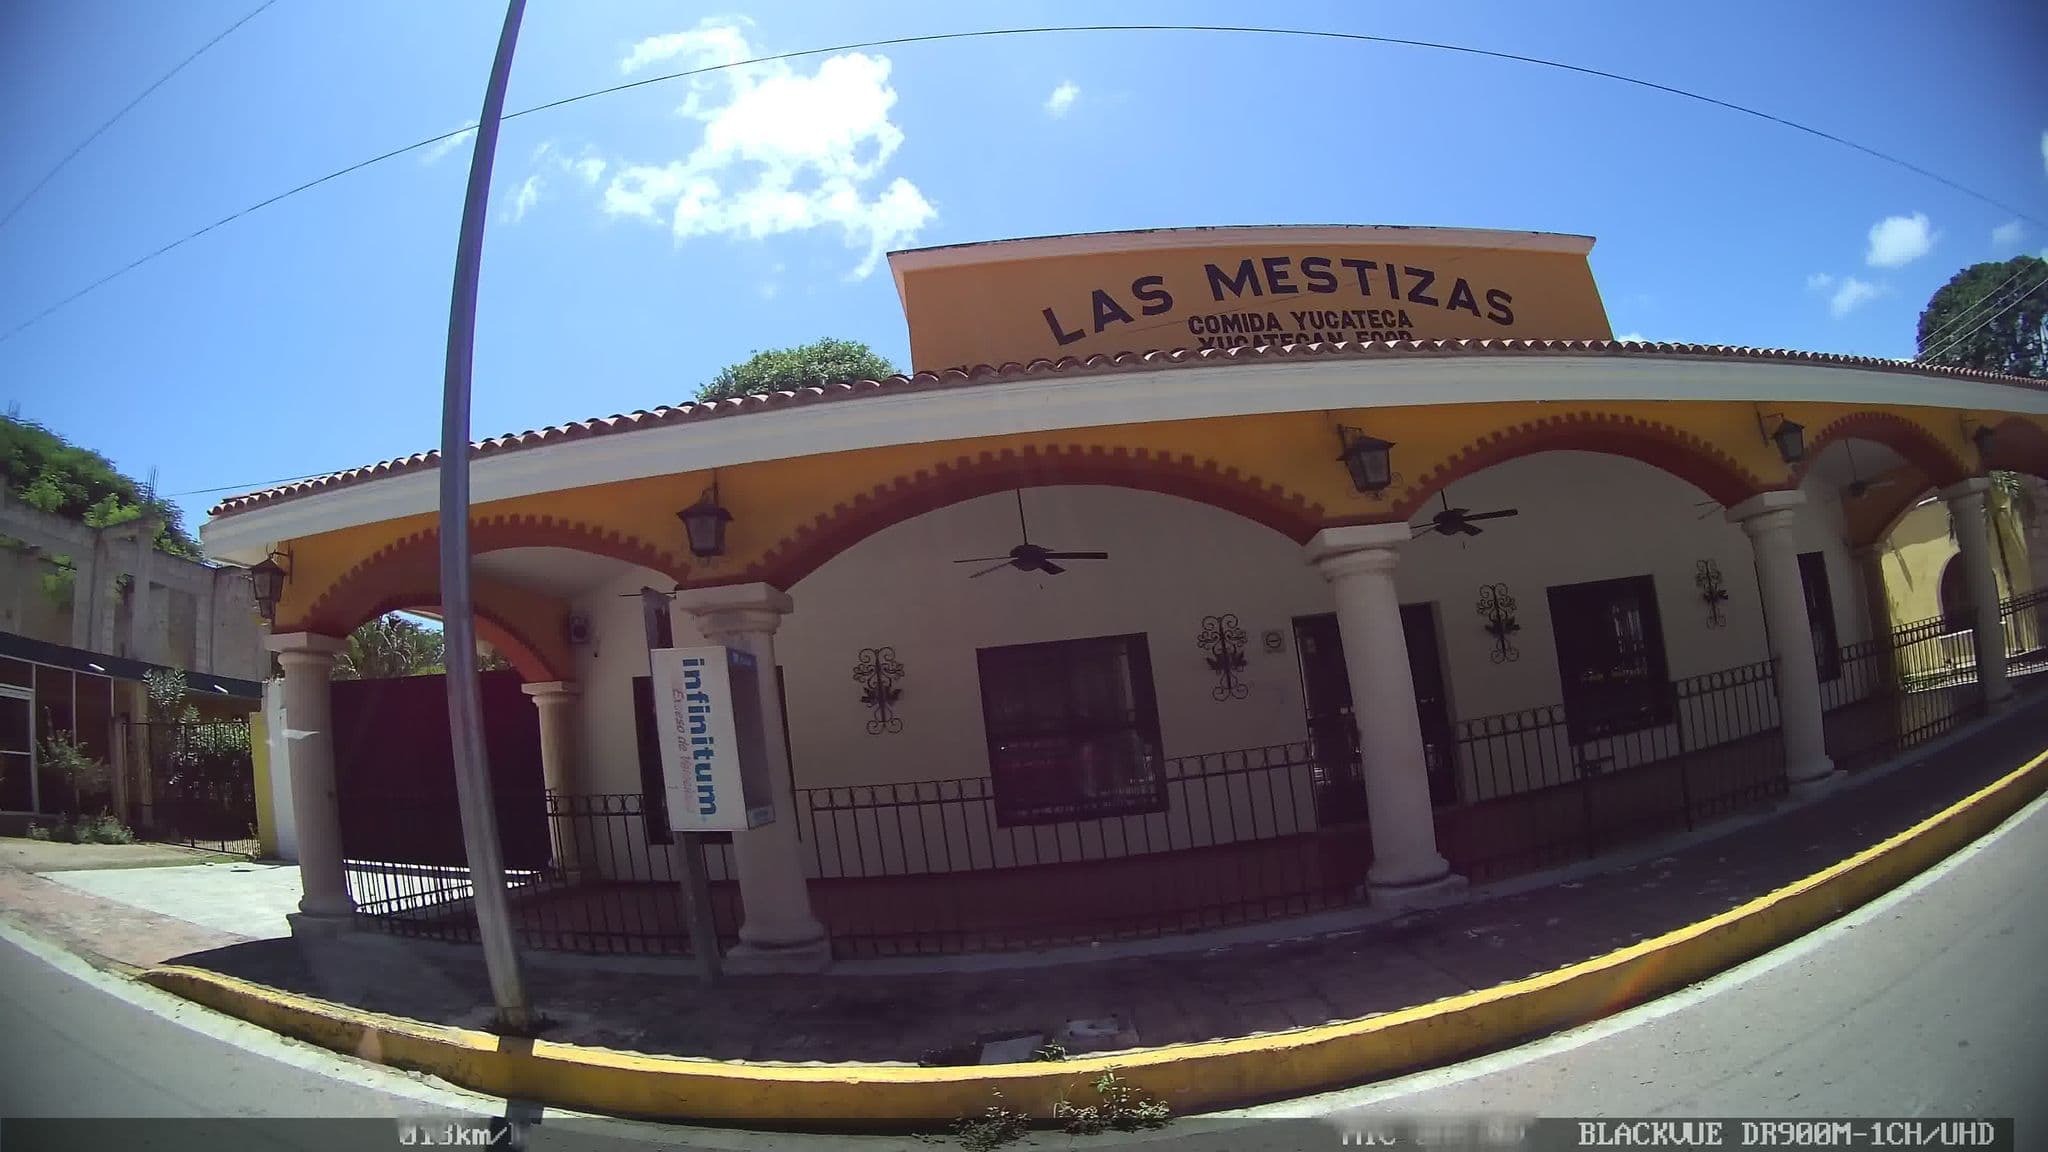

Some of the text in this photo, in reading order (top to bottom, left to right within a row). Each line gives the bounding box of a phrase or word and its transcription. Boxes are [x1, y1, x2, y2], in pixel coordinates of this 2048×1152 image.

[1042, 256, 1515, 346] LAS MESTIZAS
[1188, 309, 1414, 334] COMIDA YUCATECA
[672, 688, 685, 733] Exeso
[683, 658, 717, 815] infinitum
